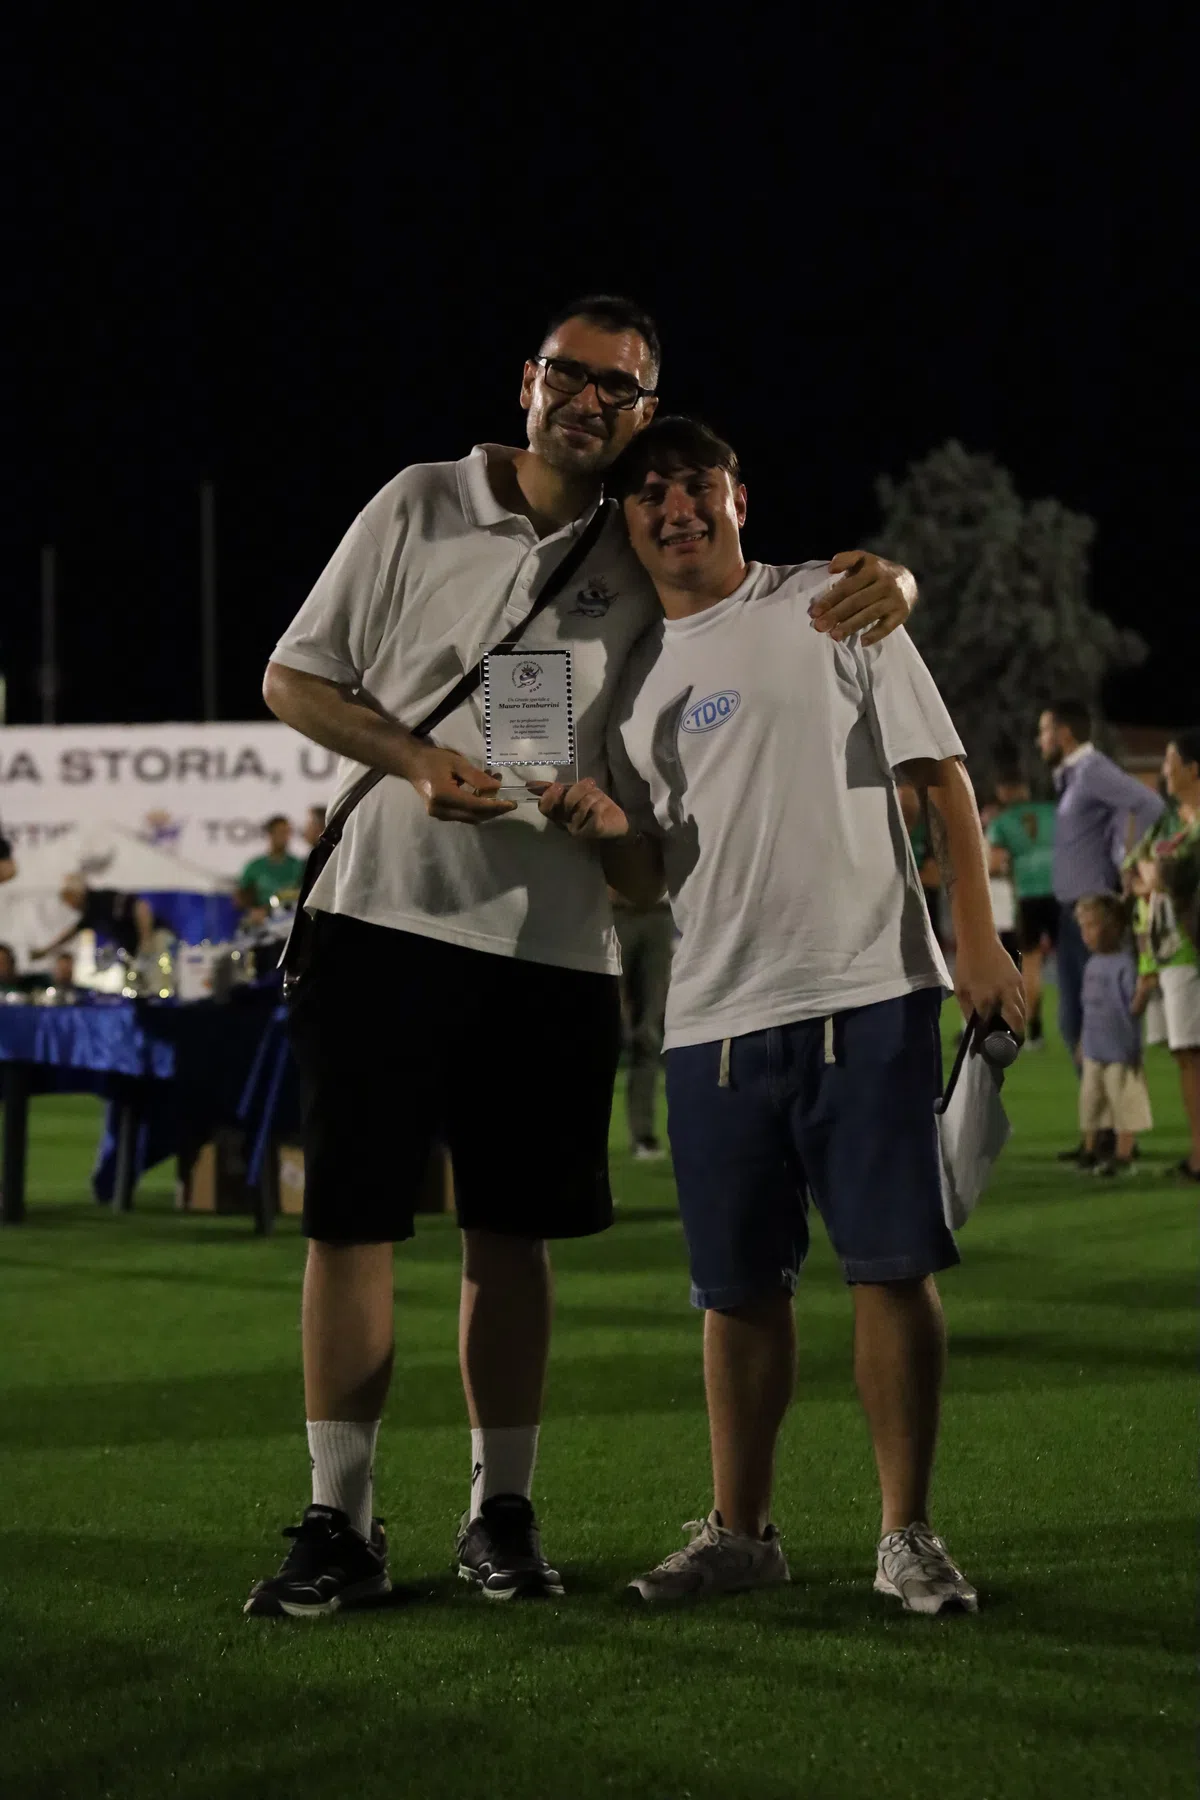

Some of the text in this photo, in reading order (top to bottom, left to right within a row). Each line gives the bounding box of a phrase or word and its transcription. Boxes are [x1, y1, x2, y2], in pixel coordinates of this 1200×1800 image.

[691, 696, 731, 728] TDQ
[0, 748, 45, 788] A
[60, 746, 283, 789] STORIA,
